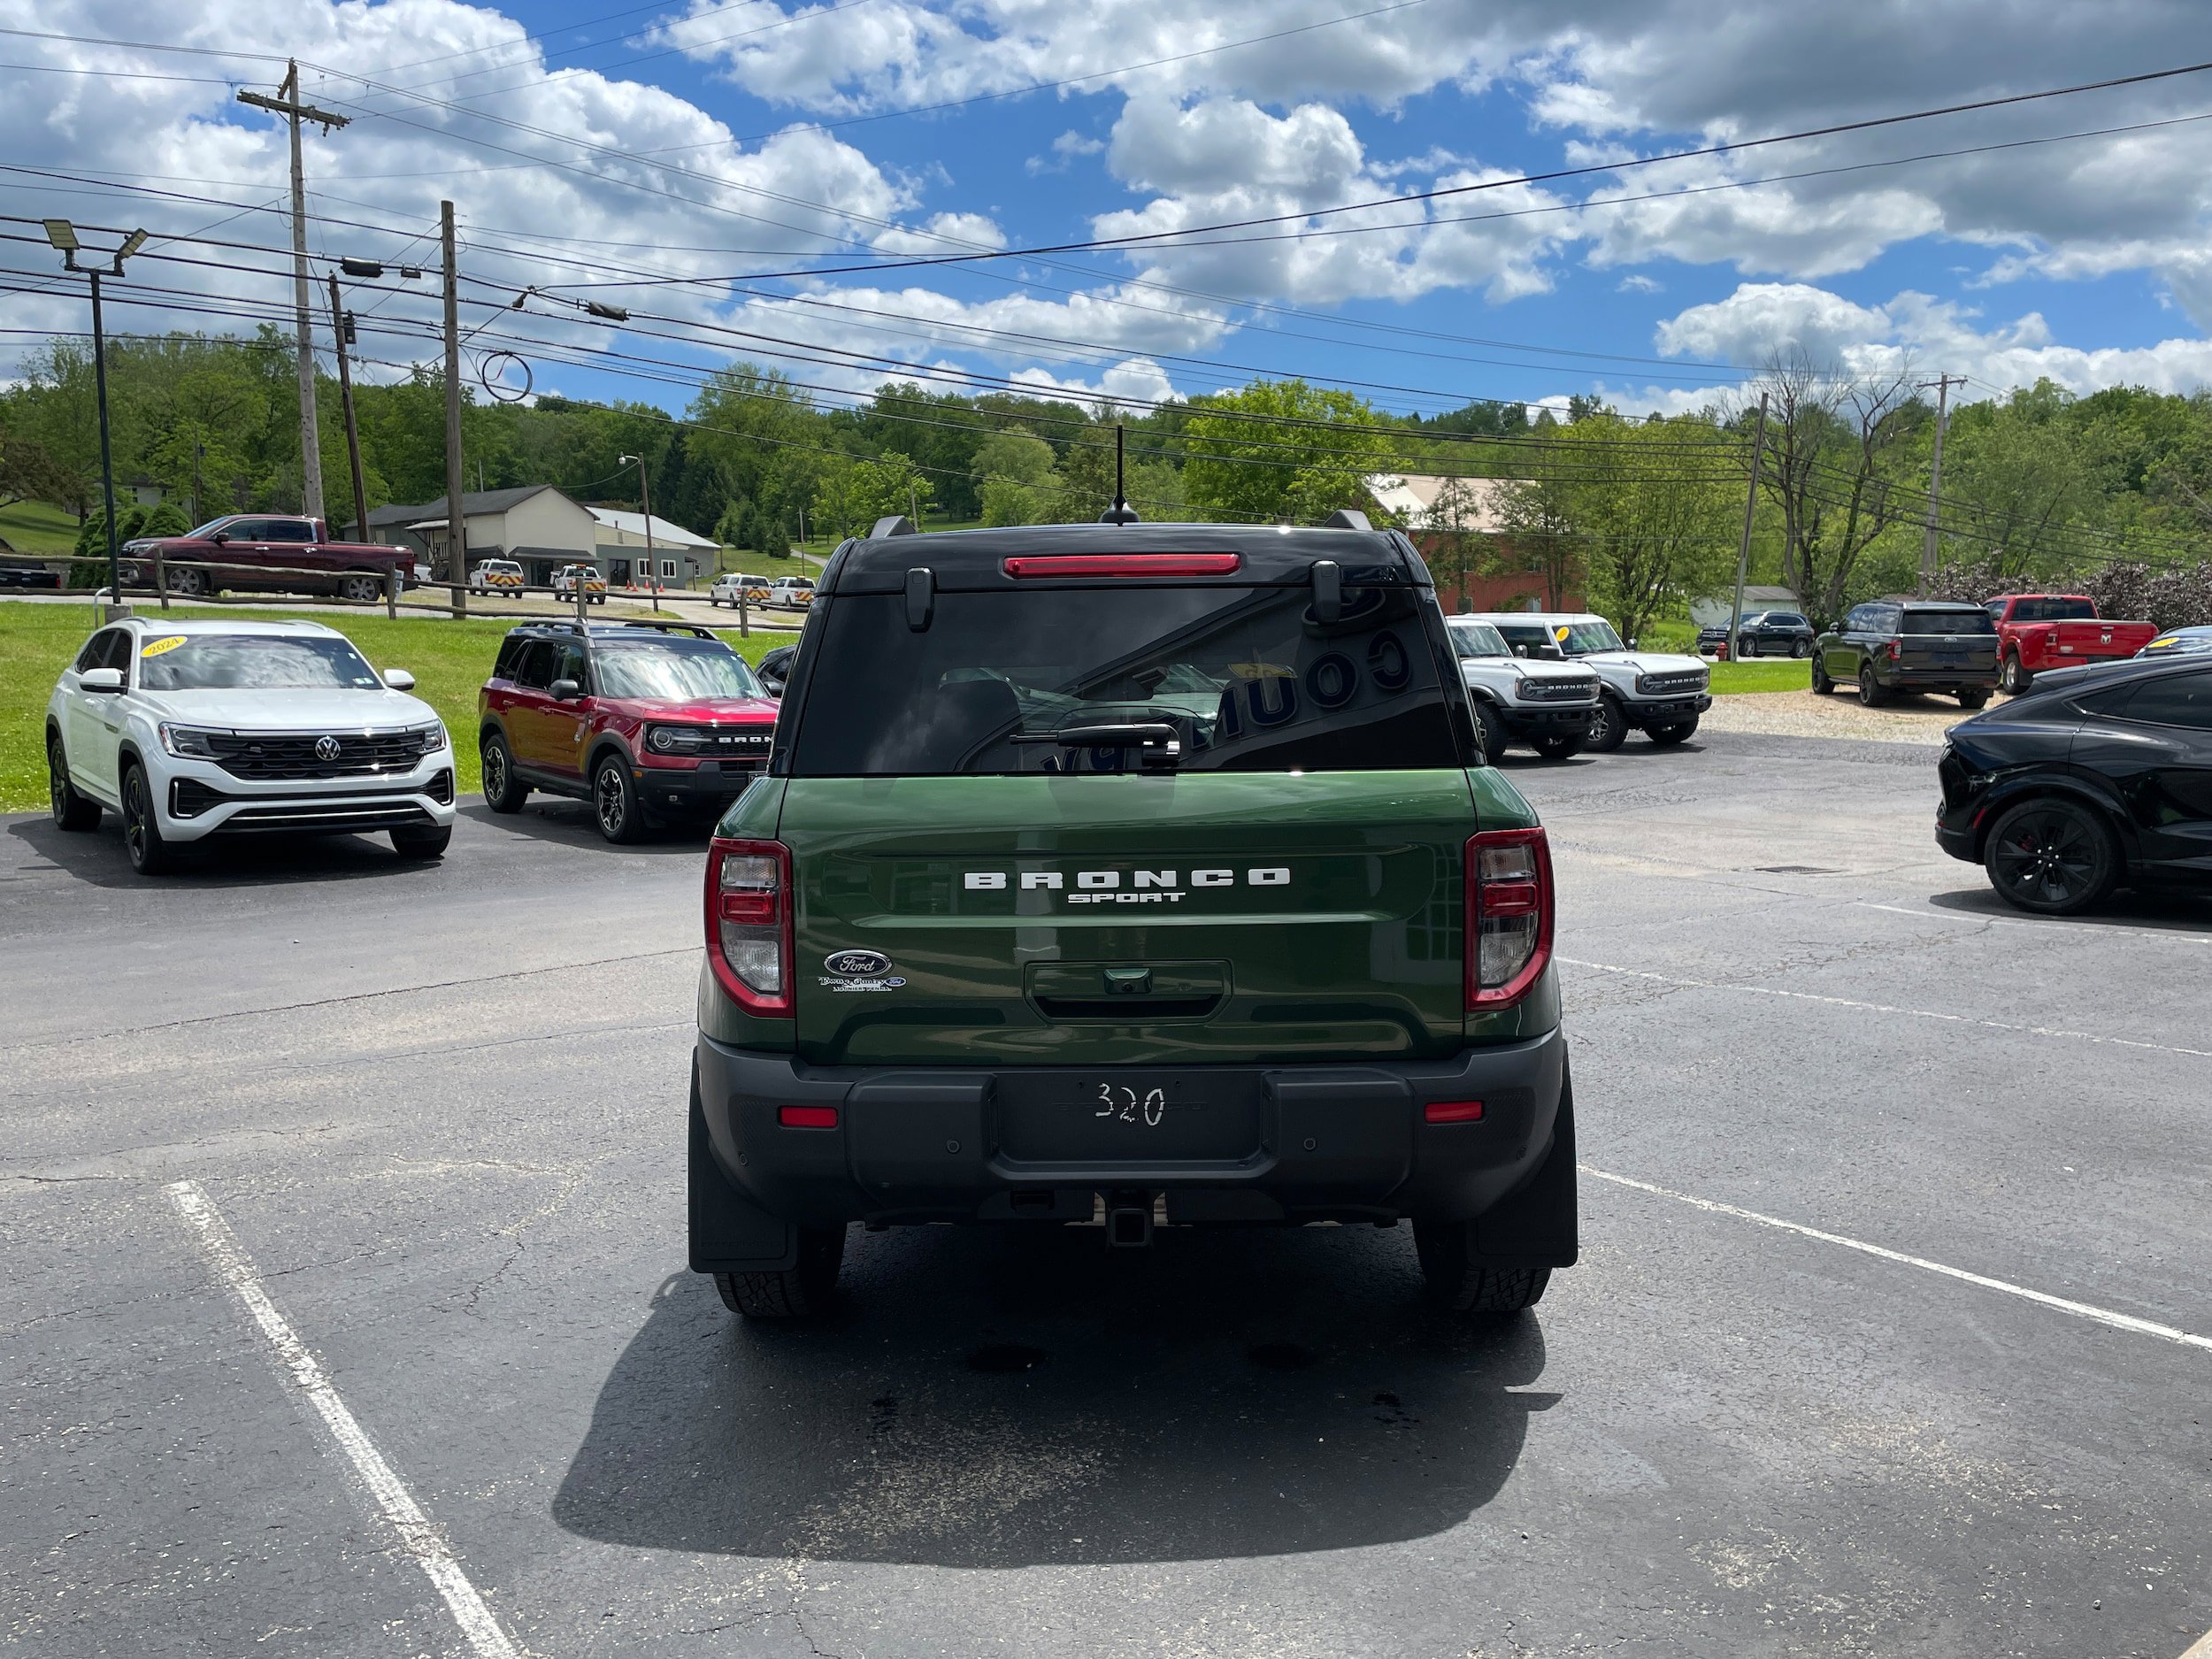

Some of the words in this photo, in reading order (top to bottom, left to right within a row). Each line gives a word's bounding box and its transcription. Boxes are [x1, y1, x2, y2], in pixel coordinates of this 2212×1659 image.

[149, 637, 179, 654] 2024
[964, 868, 1290, 889] BRONCO
[1067, 892, 1186, 903] SPORT
[1095, 1082, 1165, 1125] 320
